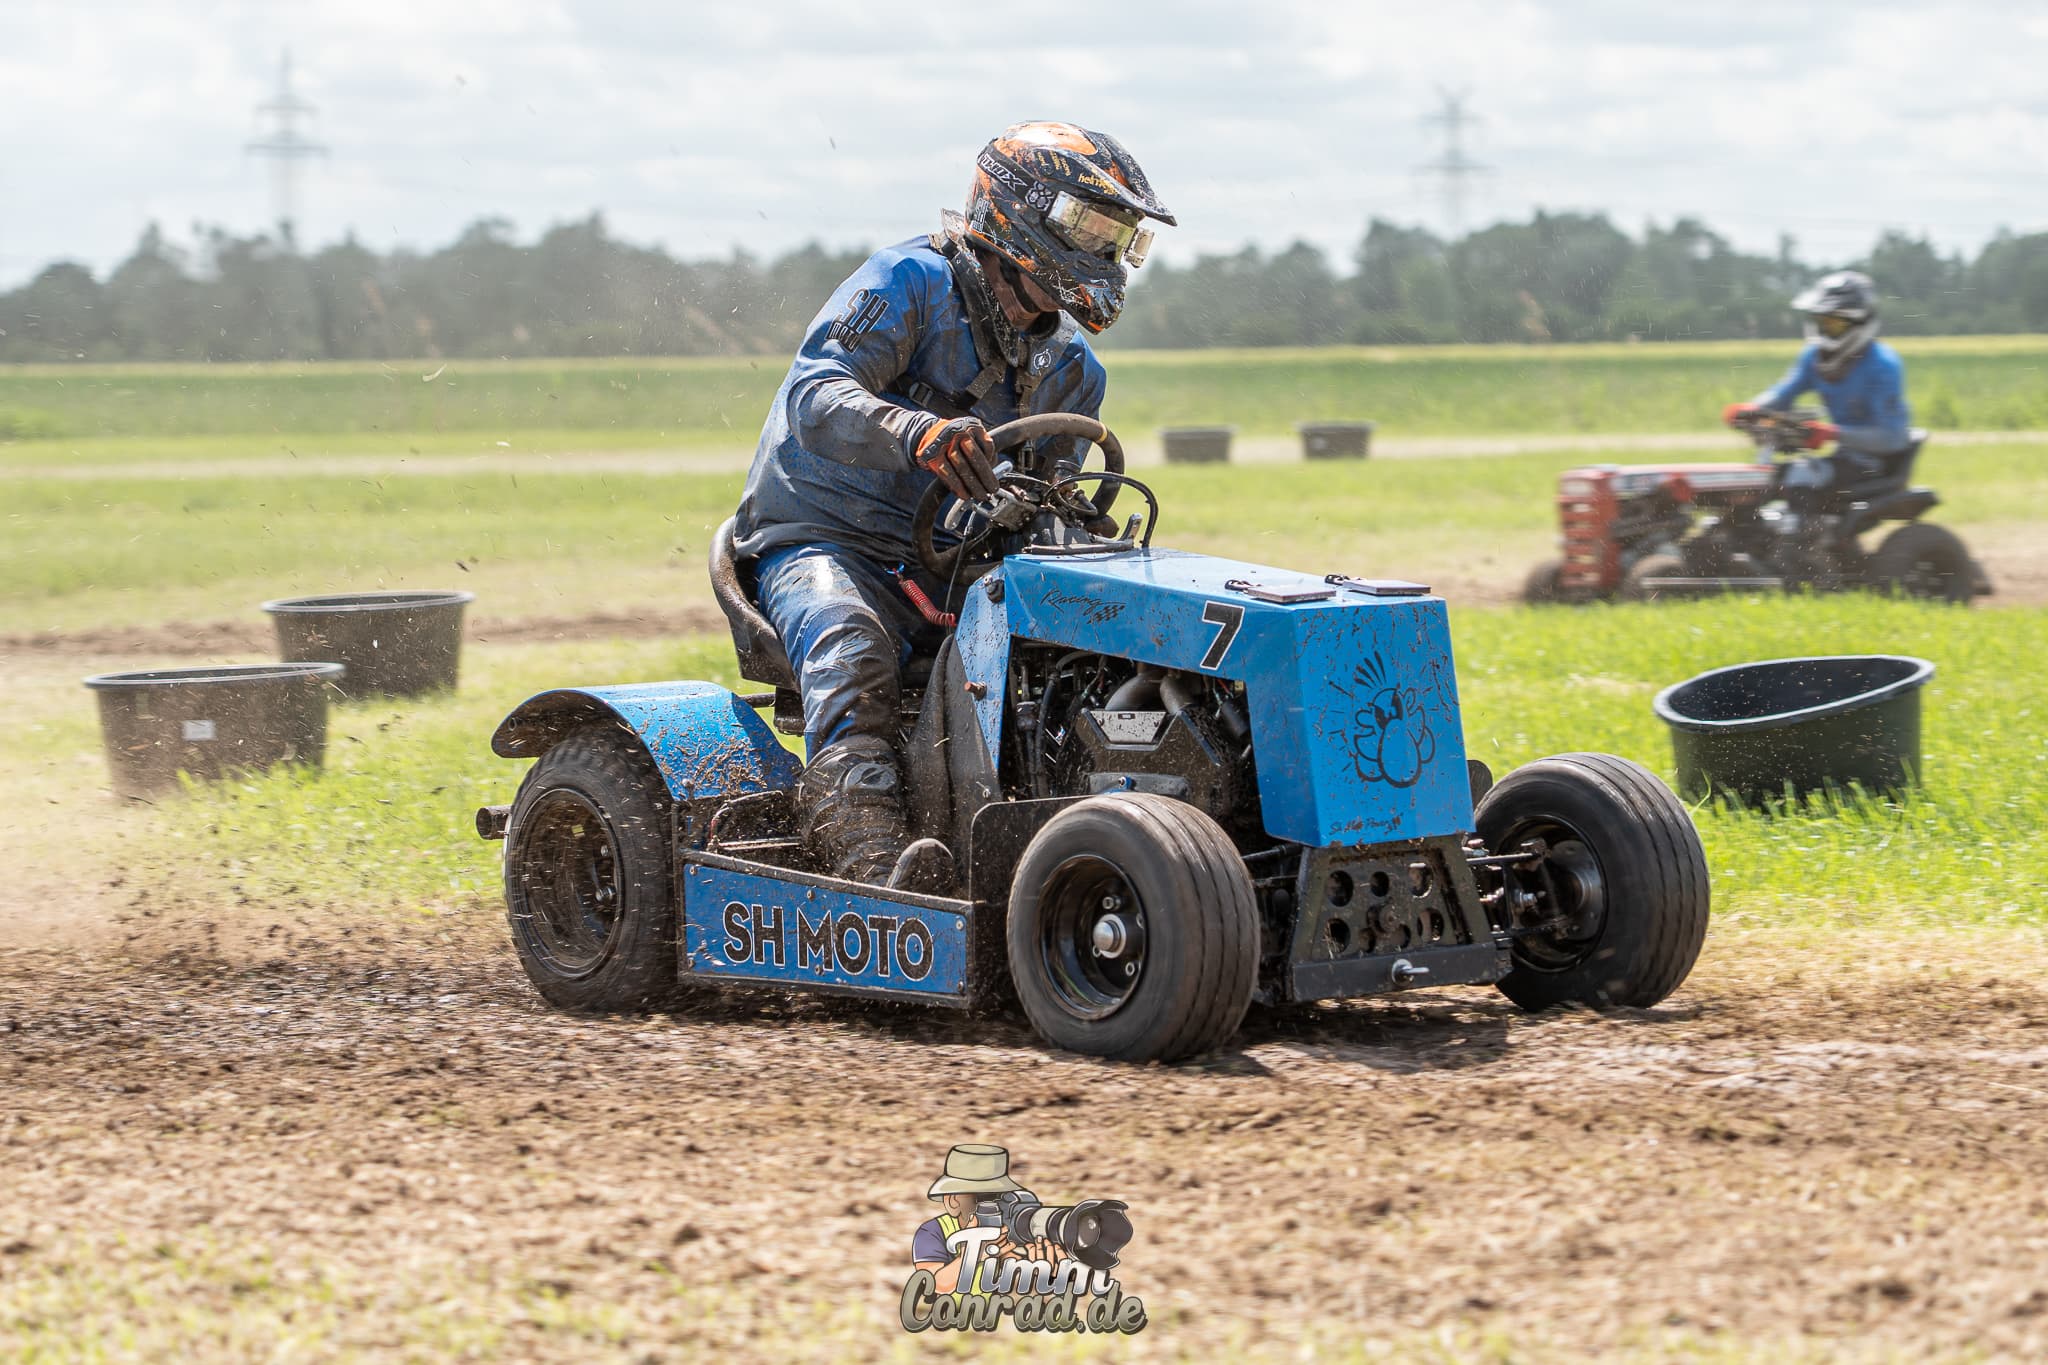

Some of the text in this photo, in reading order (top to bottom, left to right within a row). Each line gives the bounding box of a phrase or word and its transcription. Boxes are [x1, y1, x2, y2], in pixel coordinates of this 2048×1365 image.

[833, 287, 889, 335] SH
[1040, 588, 1118, 616] Racing
[1200, 600, 1245, 670] 7
[723, 901, 934, 982] SH MOTO
